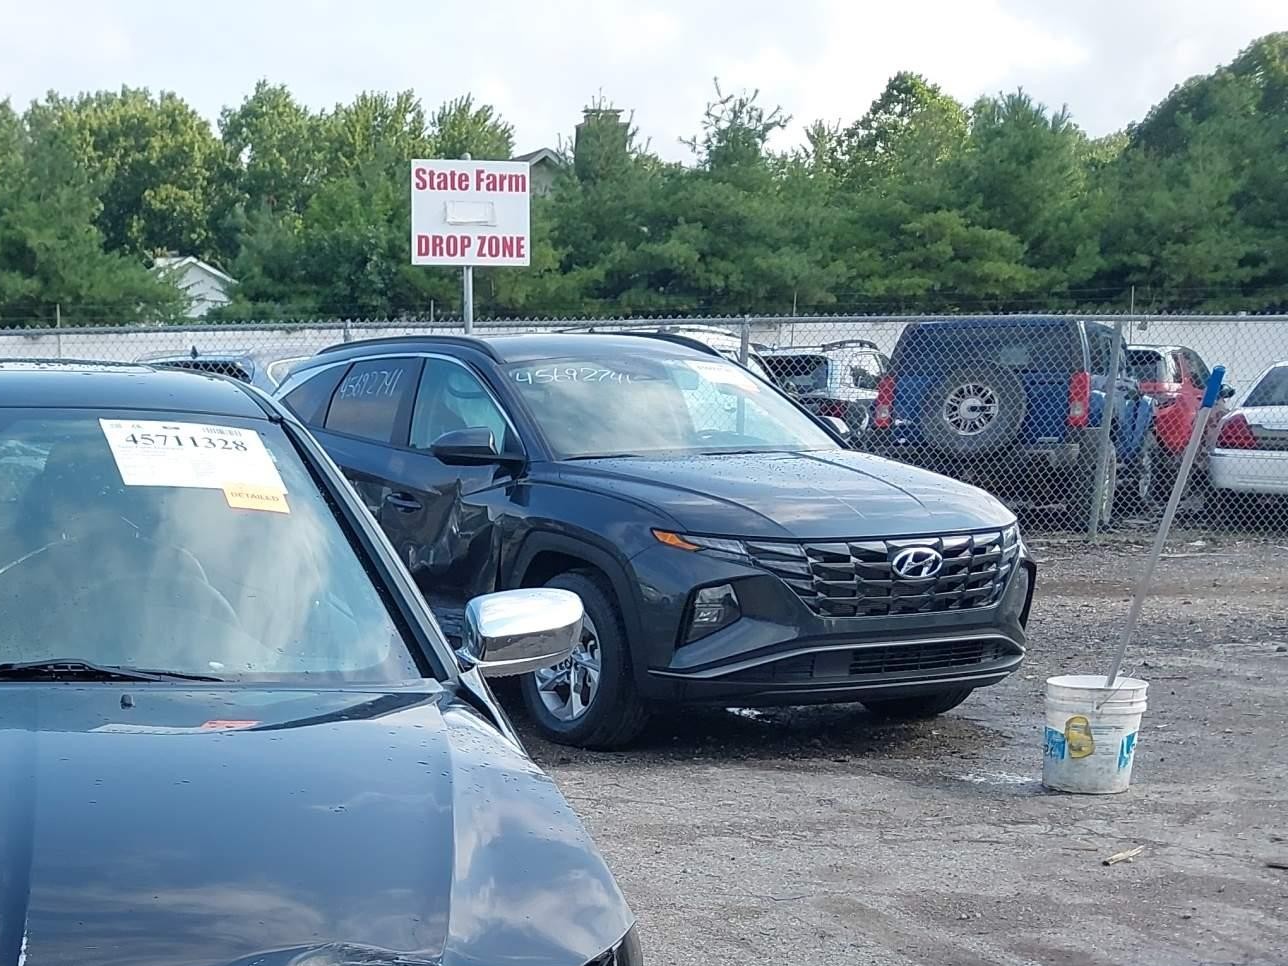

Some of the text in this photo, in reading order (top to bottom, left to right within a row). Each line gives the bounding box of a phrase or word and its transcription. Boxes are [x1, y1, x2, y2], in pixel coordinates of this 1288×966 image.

[415, 168, 527, 193] State Farm
[417, 235, 526, 258] DROP ZONE
[125, 432, 248, 452] 45711328
[230, 490, 280, 502] DETAILED
